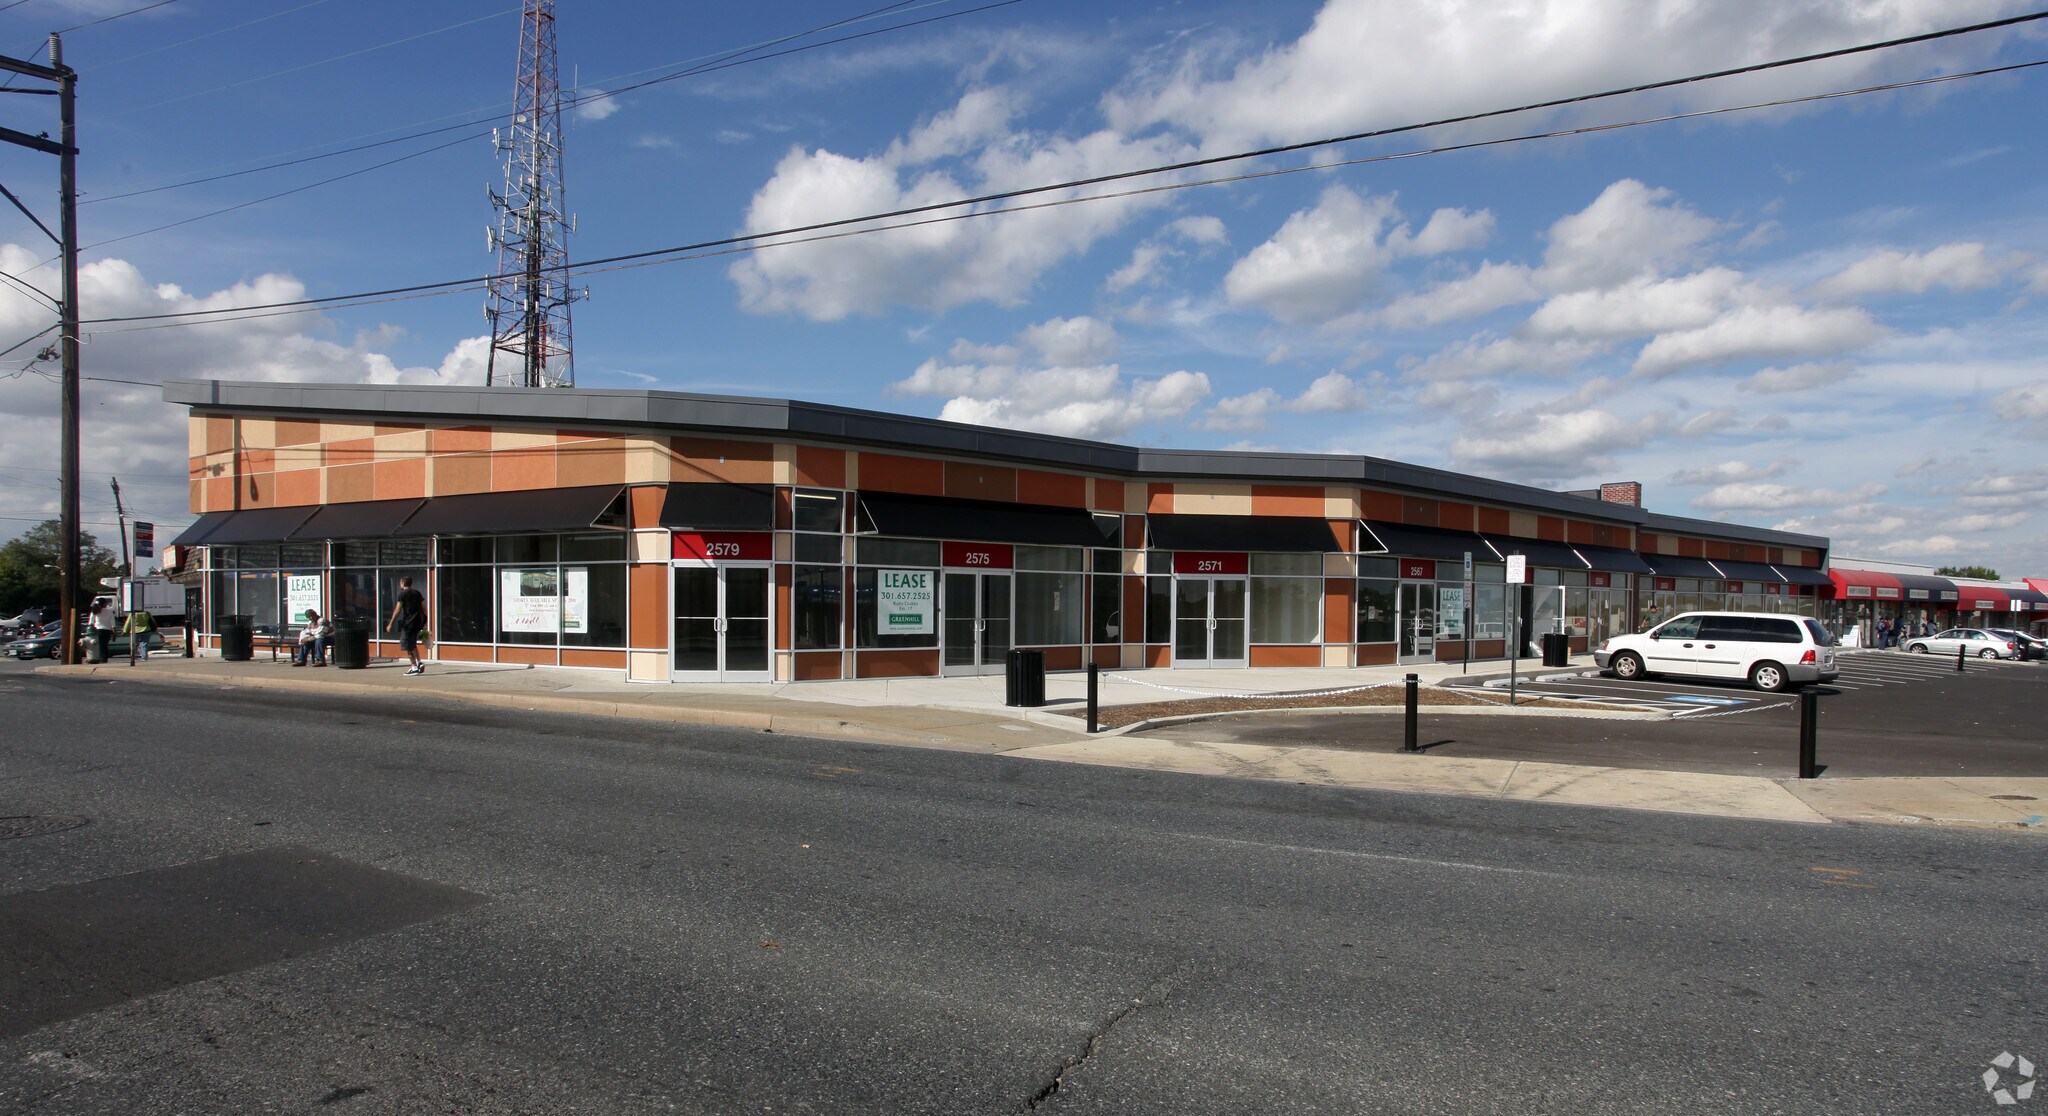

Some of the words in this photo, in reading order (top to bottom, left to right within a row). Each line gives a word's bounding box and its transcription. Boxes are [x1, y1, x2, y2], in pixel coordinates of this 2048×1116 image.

[706, 543, 740, 556] 2579
[966, 552, 990, 564] 2575
[1198, 561, 1222, 571] 2571
[1410, 566, 1424, 576] 2567
[291, 578, 316, 591] LEASE
[884, 573, 927, 588] LEASE
[881, 592, 931, 600] 301.657.2525
[1442, 590, 1461, 601] LEASE
